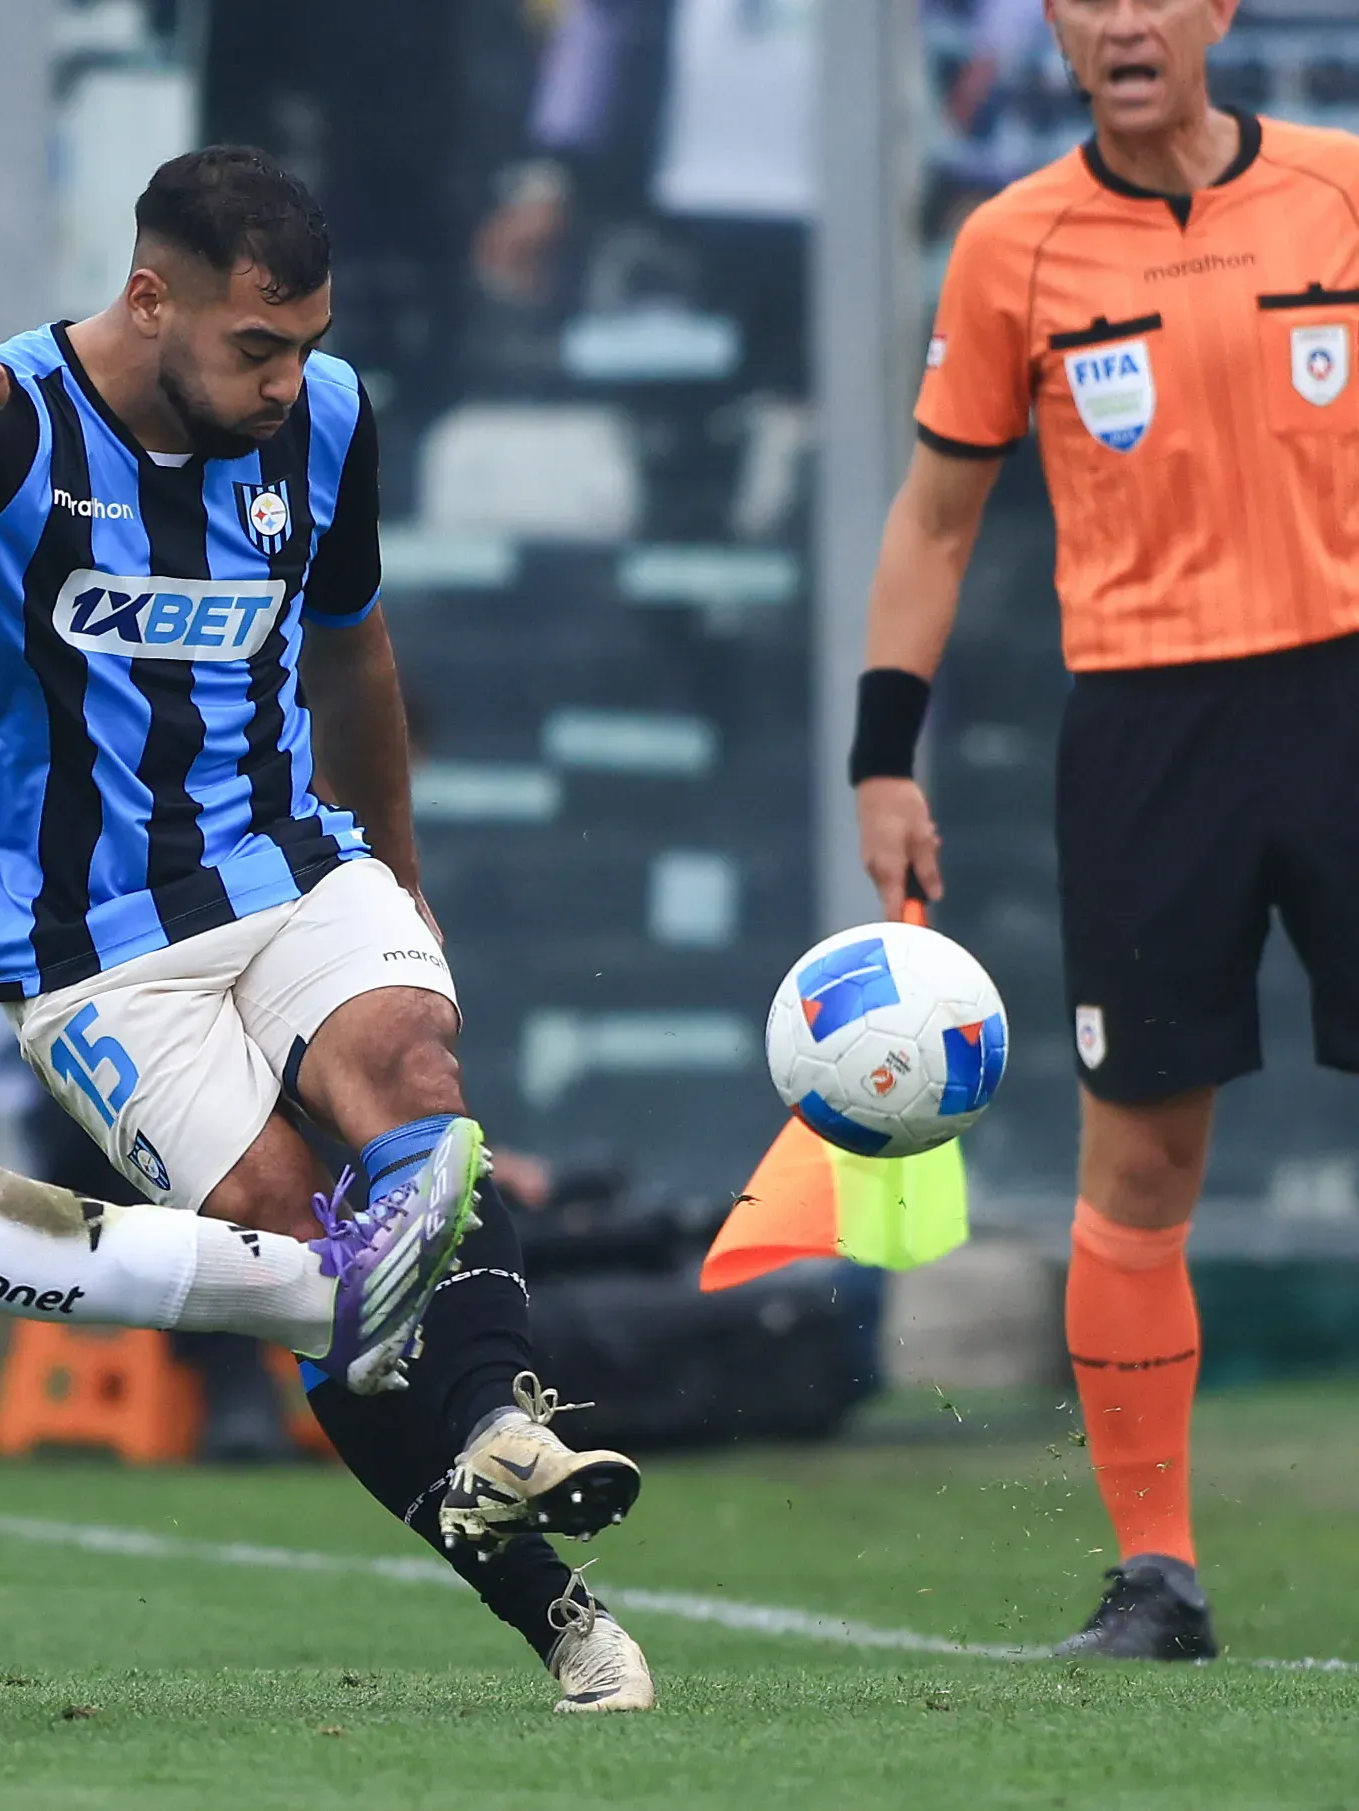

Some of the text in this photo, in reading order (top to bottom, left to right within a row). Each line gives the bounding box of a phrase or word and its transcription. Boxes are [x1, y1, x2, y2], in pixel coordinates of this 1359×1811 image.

[1143, 252, 1256, 284] marathon
[1074, 354, 1139, 387] FIFA
[69, 587, 274, 647] 1XBET
[50, 1001, 141, 1129] 15
